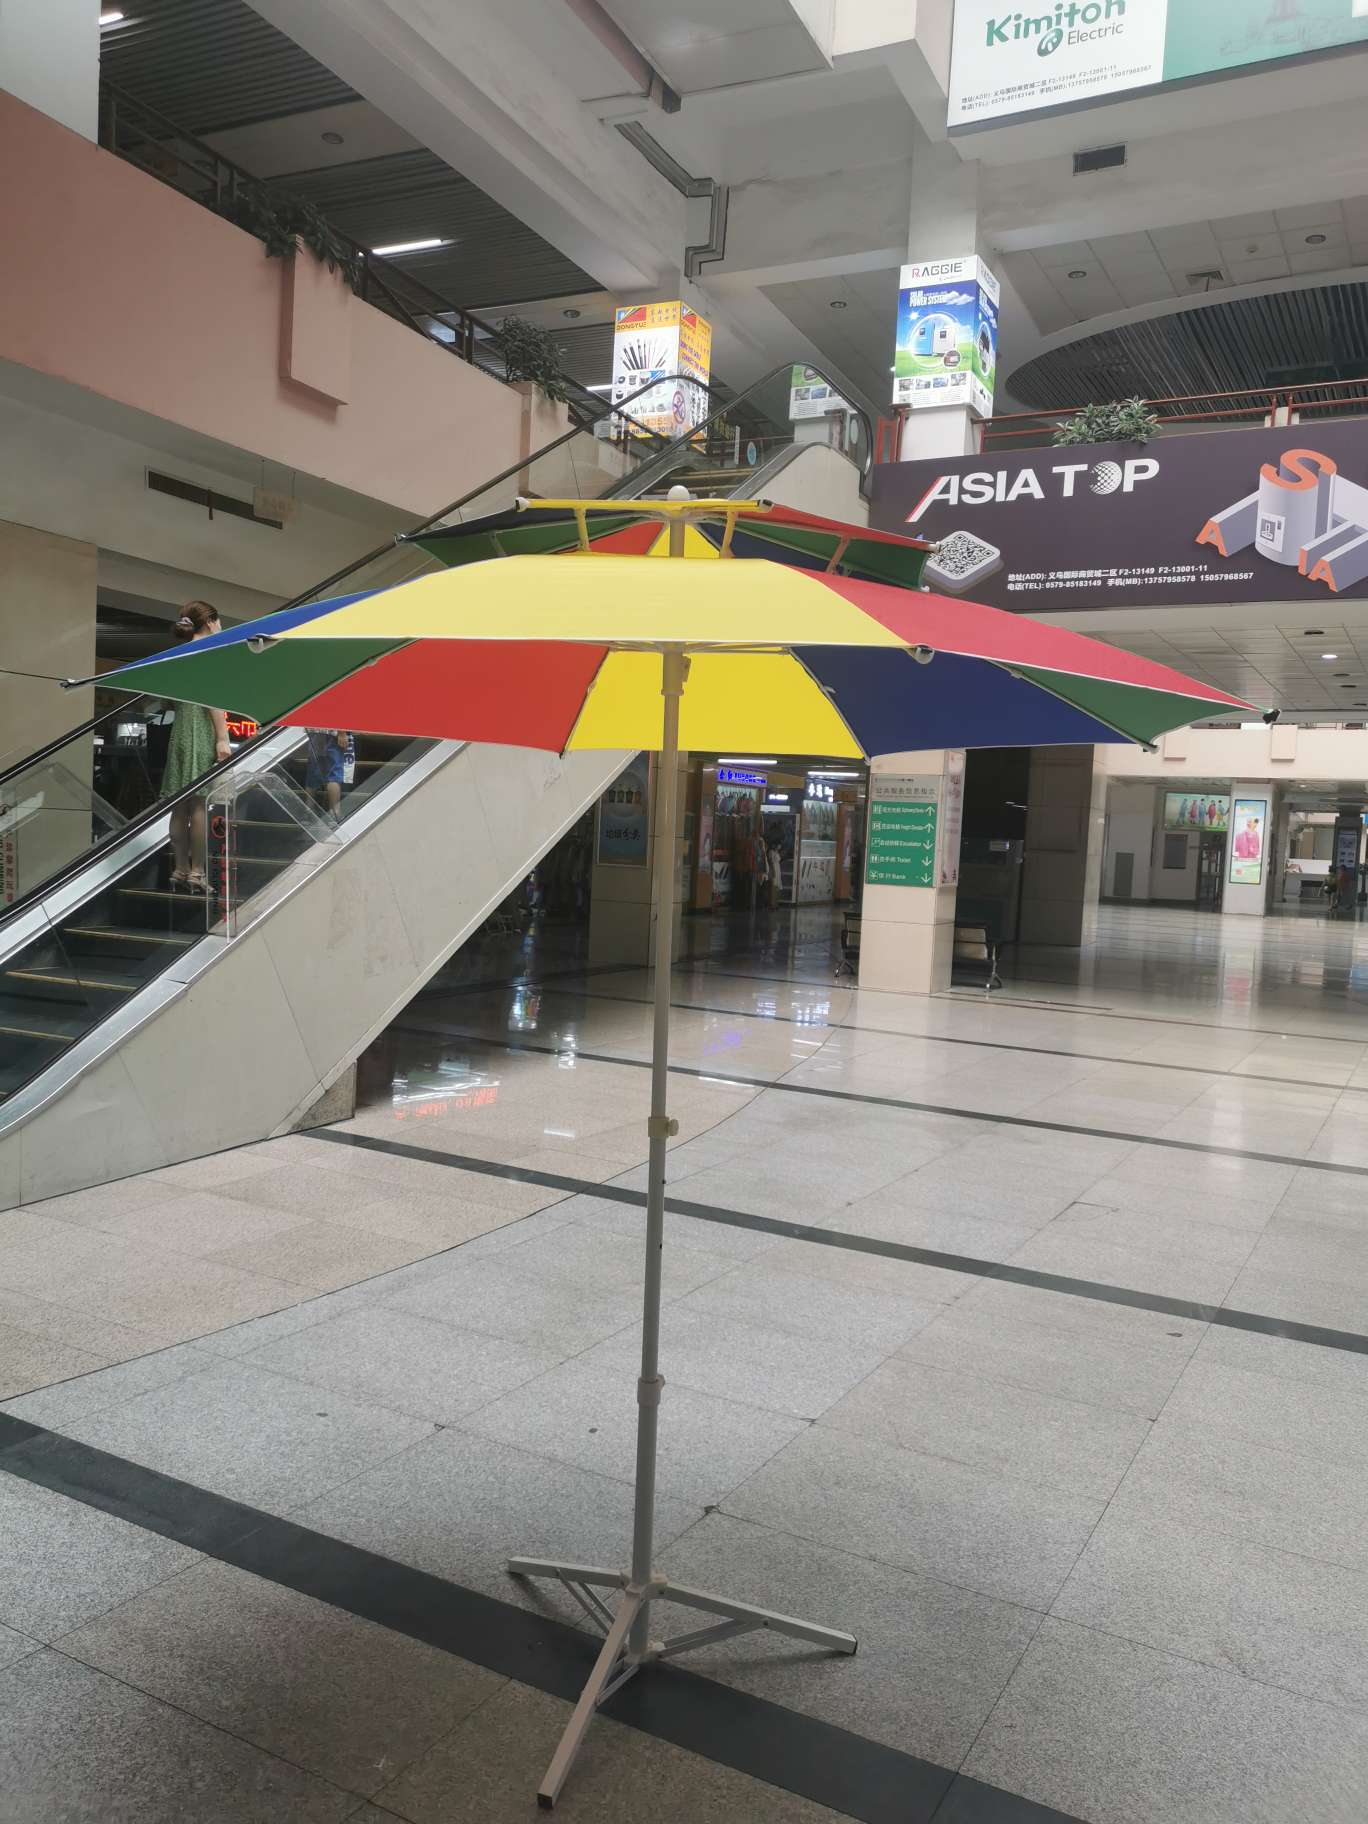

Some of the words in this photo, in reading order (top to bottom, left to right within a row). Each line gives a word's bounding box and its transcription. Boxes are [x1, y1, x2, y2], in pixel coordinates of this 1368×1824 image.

[1067, 22, 1124, 46] Electric
[911, 262, 963, 279] RAGGIE
[904, 468, 1046, 522] ASIA
[1052, 458, 1160, 497] TOP
[1007, 572, 1047, 582] 地址(ADD):
[1119, 567, 1155, 576] F2-13149
[1158, 564, 1208, 574] F2-13001-11
[1007, 582, 1045, 591] 电话(TEL):
